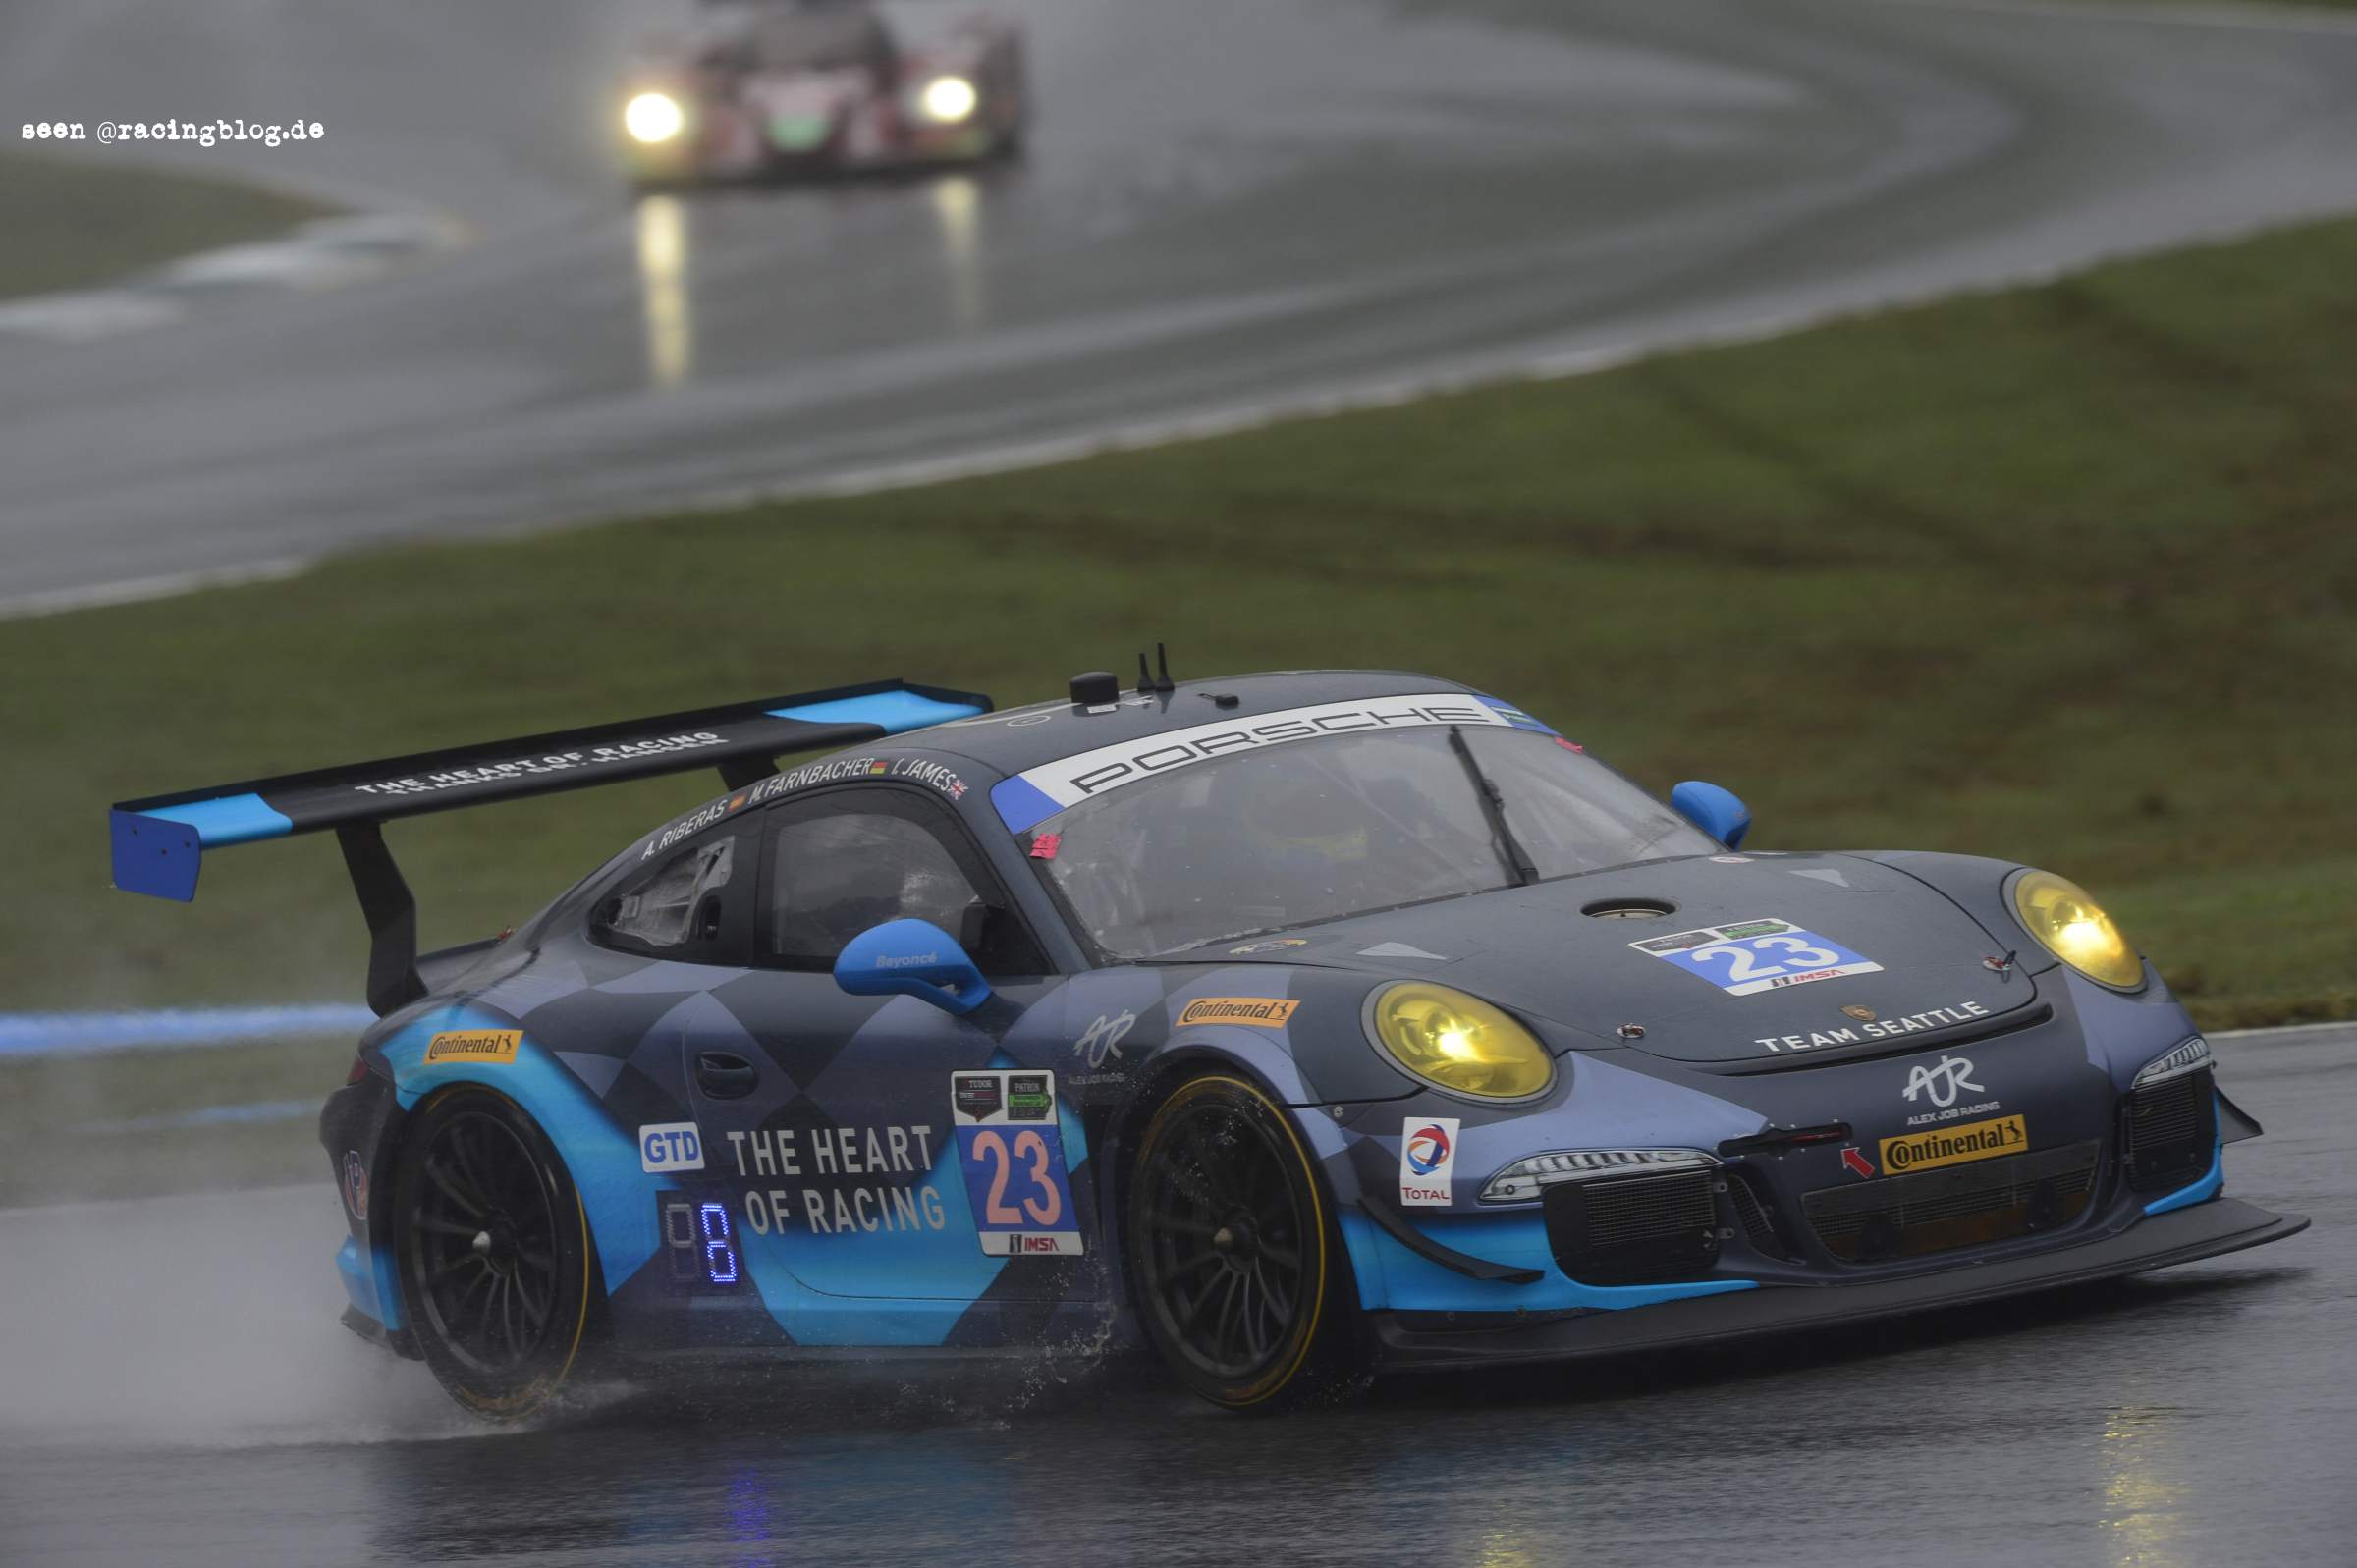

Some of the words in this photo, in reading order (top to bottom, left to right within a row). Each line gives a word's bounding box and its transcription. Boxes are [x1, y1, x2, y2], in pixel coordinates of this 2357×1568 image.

[354, 778, 426, 794] THE
[428, 760, 537, 783] HEART
[542, 752, 583, 764] OF
[592, 732, 718, 756] RACING
[1069, 707, 1489, 795] PORSCHE
[764, 757, 875, 798] FARNBACHER
[902, 759, 953, 792] JAMES
[659, 799, 728, 850] RIBERAS
[1691, 937, 1839, 982] 23
[1793, 969, 1846, 983] IMSA
[1182, 1000, 1279, 1023] Continental
[1754, 1029, 1860, 1053] TEAM
[1862, 1000, 1990, 1038] SEATTLE
[428, 1035, 502, 1059] Continental
[1907, 1114, 1937, 1126] ALEX
[1938, 1109, 1959, 1122] JOB
[1960, 1101, 2001, 1117] RACING
[644, 1130, 699, 1164] GTD
[727, 1129, 801, 1177] THE
[811, 1125, 932, 1174] HEART
[1886, 1123, 2004, 1171] Continental
[972, 1130, 1062, 1226] 23
[1402, 1187, 1450, 1200] TOTAL
[745, 1189, 790, 1236] OF
[802, 1185, 946, 1234] RACING
[1024, 1237, 1060, 1252] IMSA
